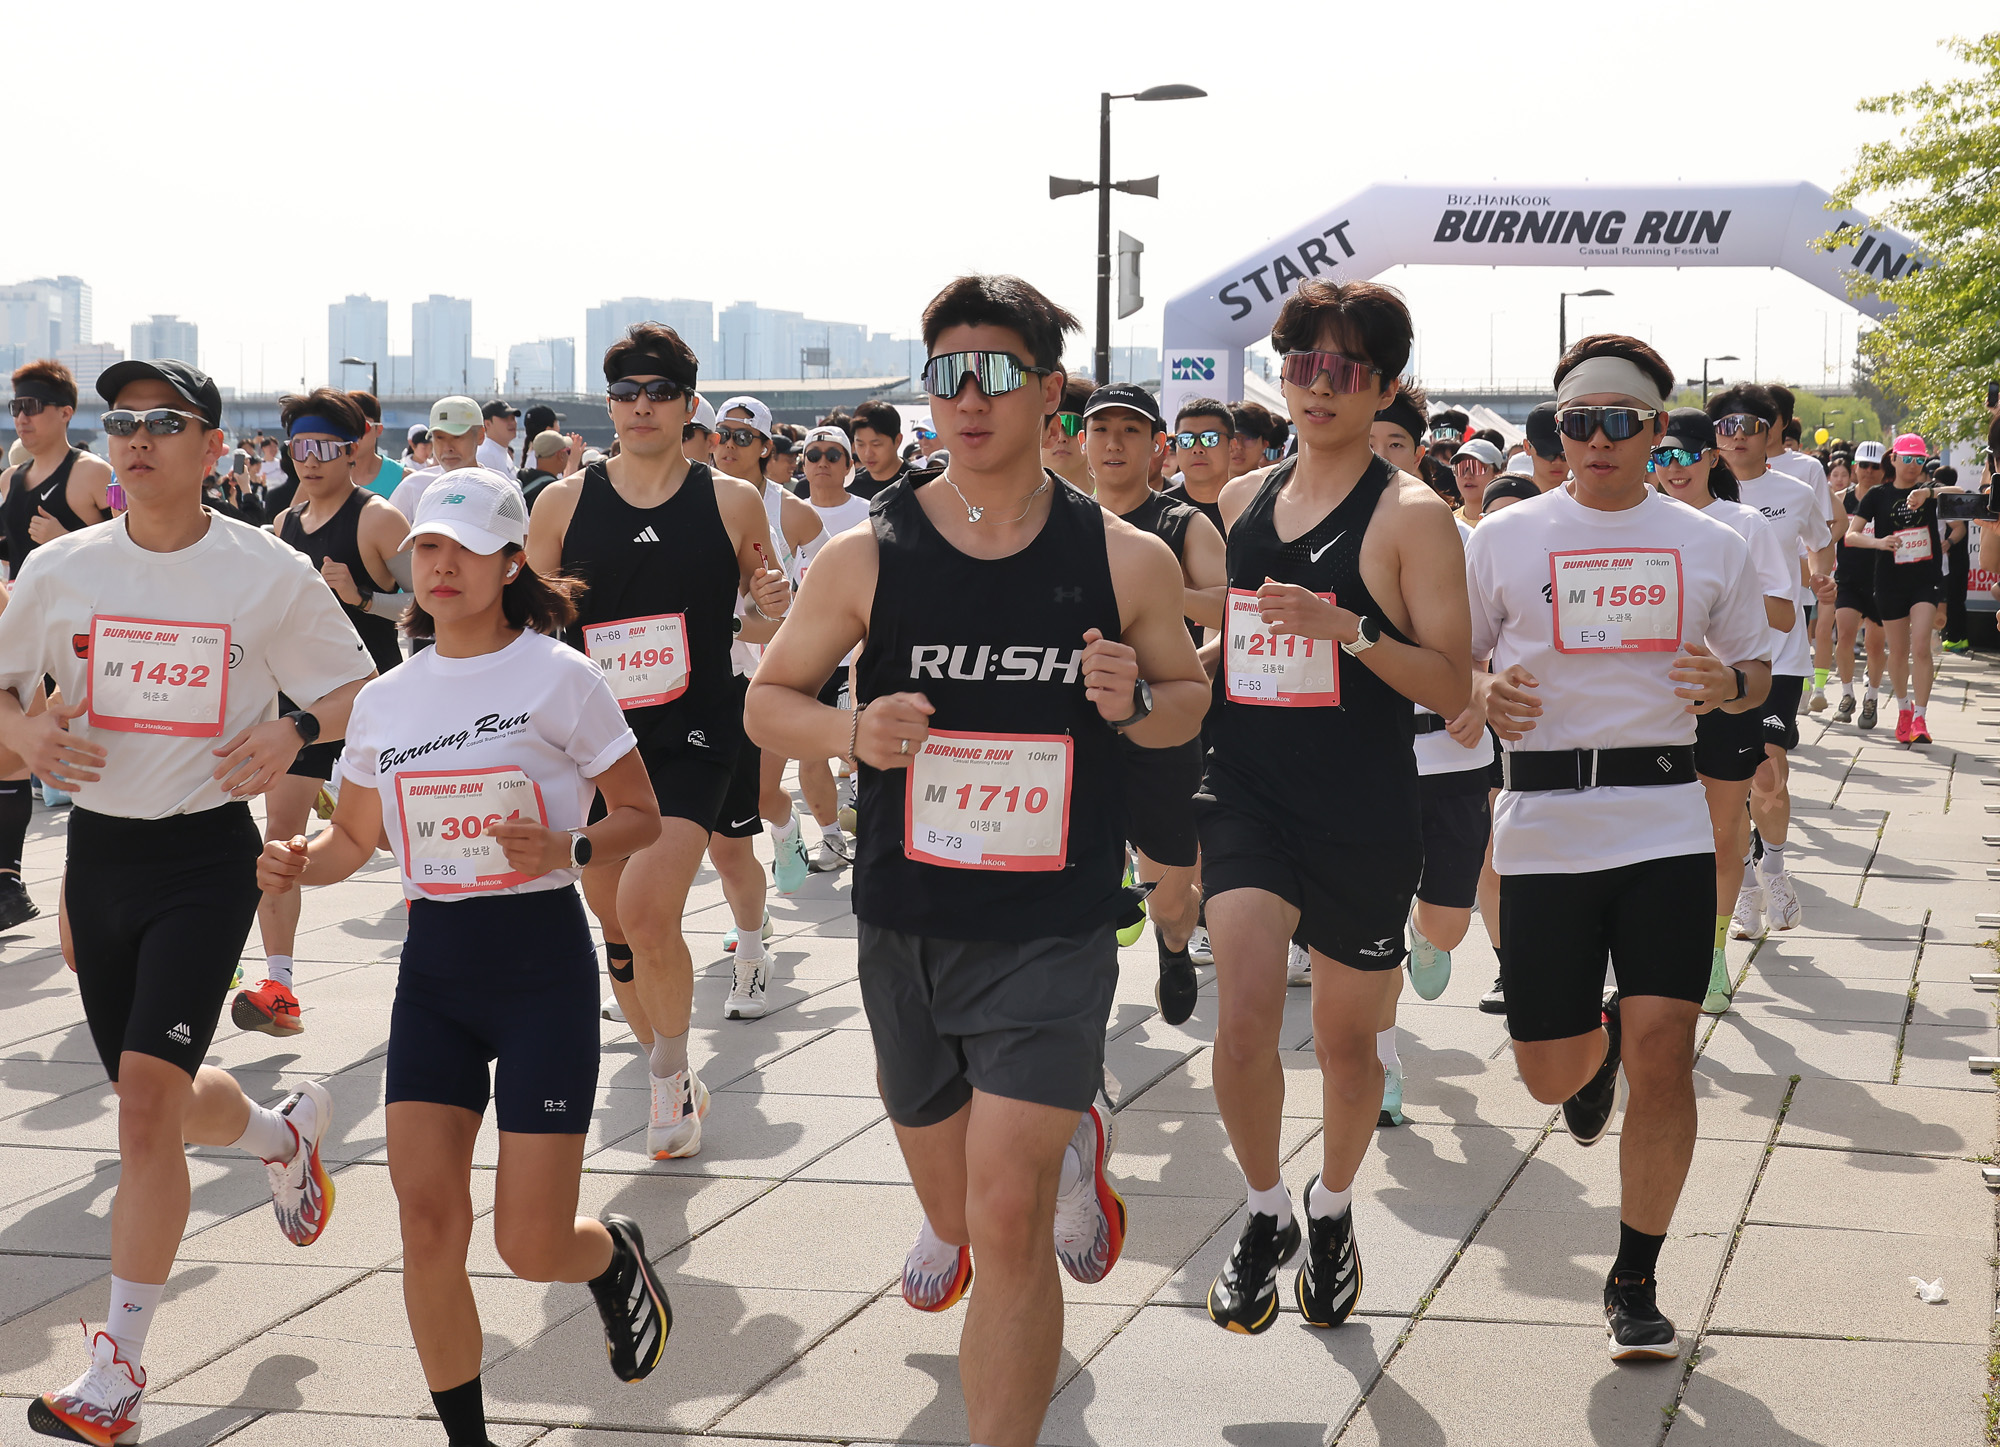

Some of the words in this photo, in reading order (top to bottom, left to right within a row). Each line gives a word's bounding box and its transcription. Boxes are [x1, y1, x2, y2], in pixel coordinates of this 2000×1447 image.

[1433, 210, 1626, 244] BURNING
[1633, 210, 1731, 244] RUN
[1579, 246, 1618, 255] Casual
[1622, 246, 1670, 256] Running
[1674, 246, 1719, 255] Festival
[1218, 219, 1356, 321] START
[1905, 539, 1928, 549] 3595
[1563, 560, 1609, 569] BURNING
[1611, 558, 1634, 567] RUN
[1569, 590, 1586, 603] M
[1593, 585, 1666, 607] 1569
[1234, 601, 1262, 613] BURNIN
[629, 626, 647, 636] RUN
[655, 624, 677, 632] 10km
[103, 628, 153, 640] BURNING
[154, 631, 180, 643] RUN
[191, 635, 218, 645] 10km
[595, 630, 621, 642] A-68
[1581, 631, 1606, 642] E-9
[1234, 635, 1246, 650] M
[1248, 633, 1314, 658] 2111
[601, 658, 612, 670] M
[618, 647, 674, 671] 1496
[104, 661, 124, 677] M
[130, 661, 210, 688] 1432
[1238, 679, 1262, 691] F-53
[379, 729, 471, 774] Burning
[474, 712, 530, 739] Run
[924, 744, 982, 760] BURNING
[984, 749, 1014, 761] RUN
[1028, 751, 1058, 762] 10km
[409, 783, 457, 796] BURNING
[459, 782, 484, 794] RUN
[497, 779, 526, 790] 10km
[925, 785, 947, 803] M
[955, 784, 1049, 814] 1710
[417, 821, 435, 837] W
[928, 831, 962, 849] B-73
[424, 864, 457, 876] B-36
